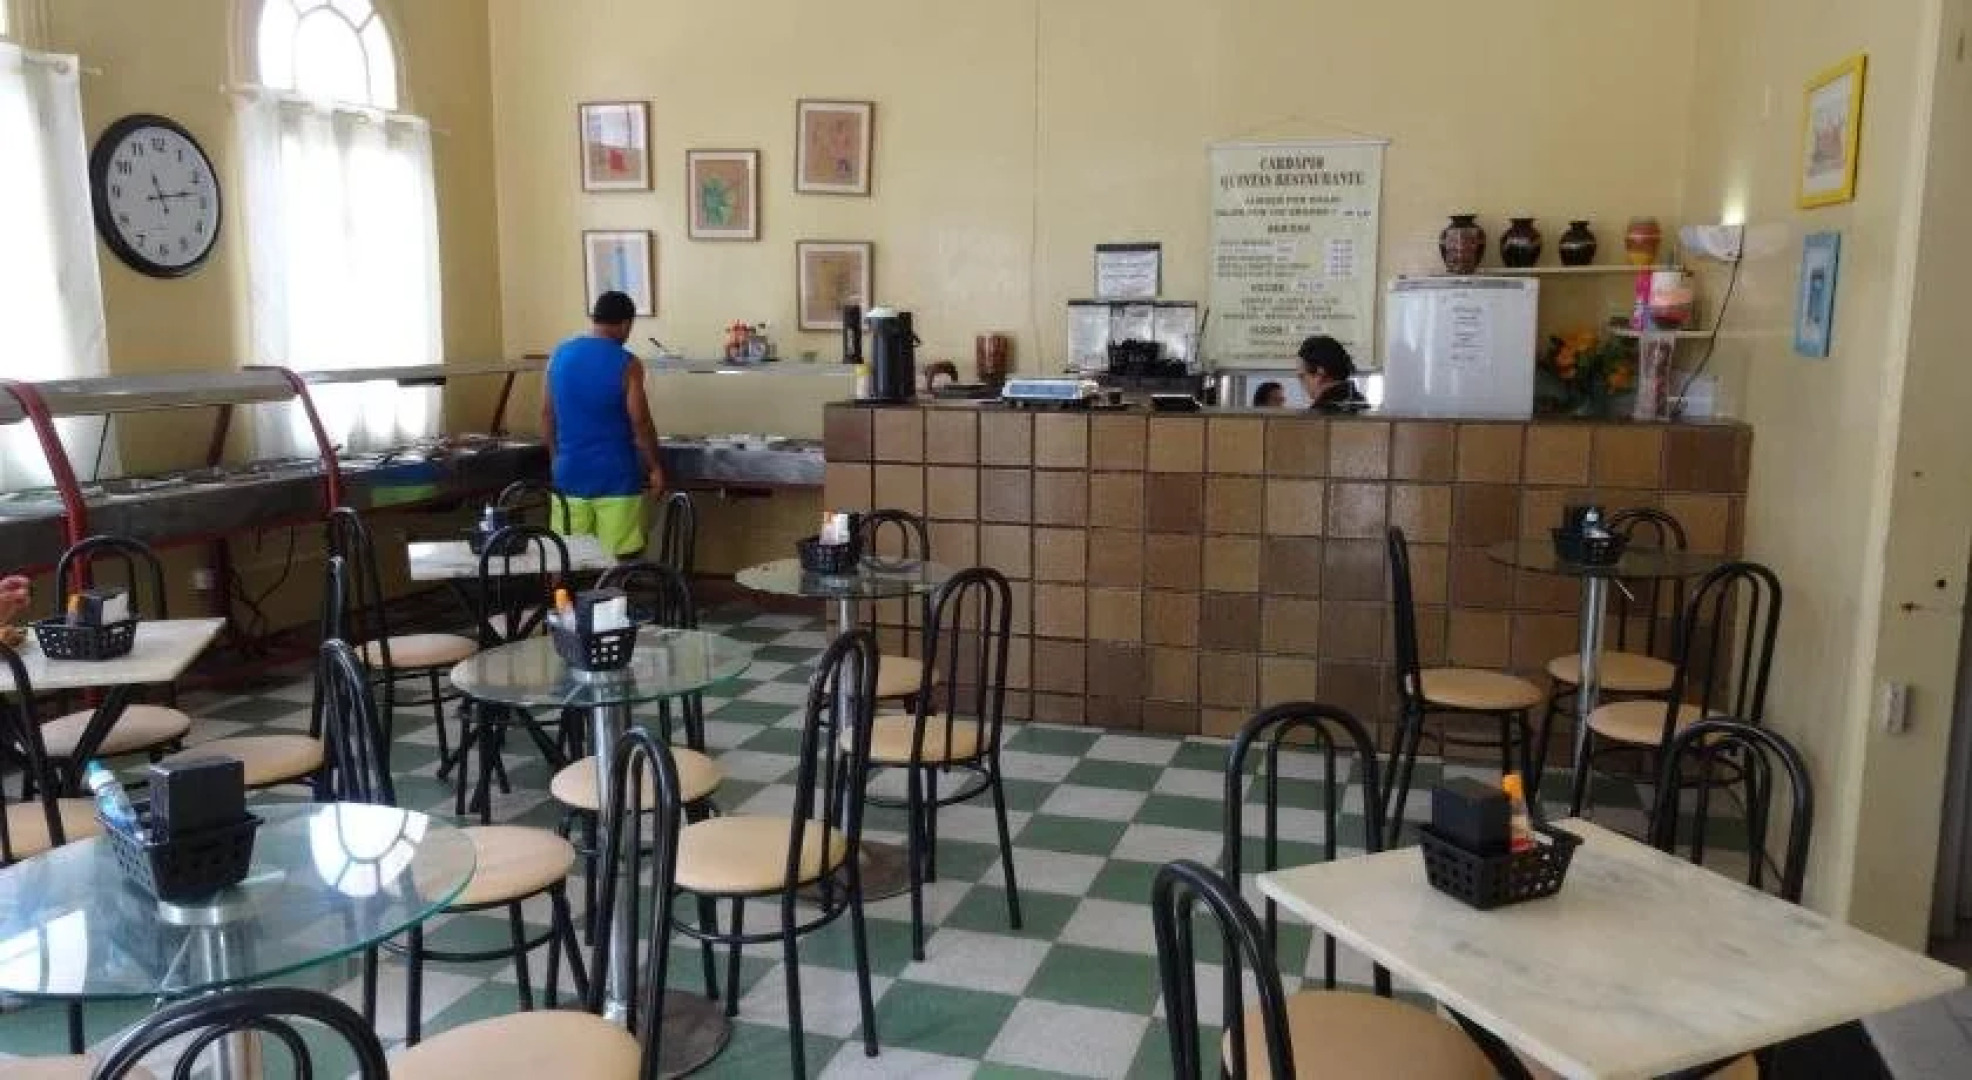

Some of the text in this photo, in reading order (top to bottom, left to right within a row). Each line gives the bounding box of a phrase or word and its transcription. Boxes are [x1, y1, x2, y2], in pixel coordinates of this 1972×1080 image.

[131, 141, 144, 156] 11
[150, 137, 165, 152] 12
[115, 159, 132, 176] 10
[191, 170, 200, 184] 2
[1220, 171, 1364, 189] QUINTAS RESTAURANTE
[112, 184, 121, 199] 9
[195, 220, 204, 234] 4
[136, 233, 146, 248] 7
[159, 243, 169, 257] 6
